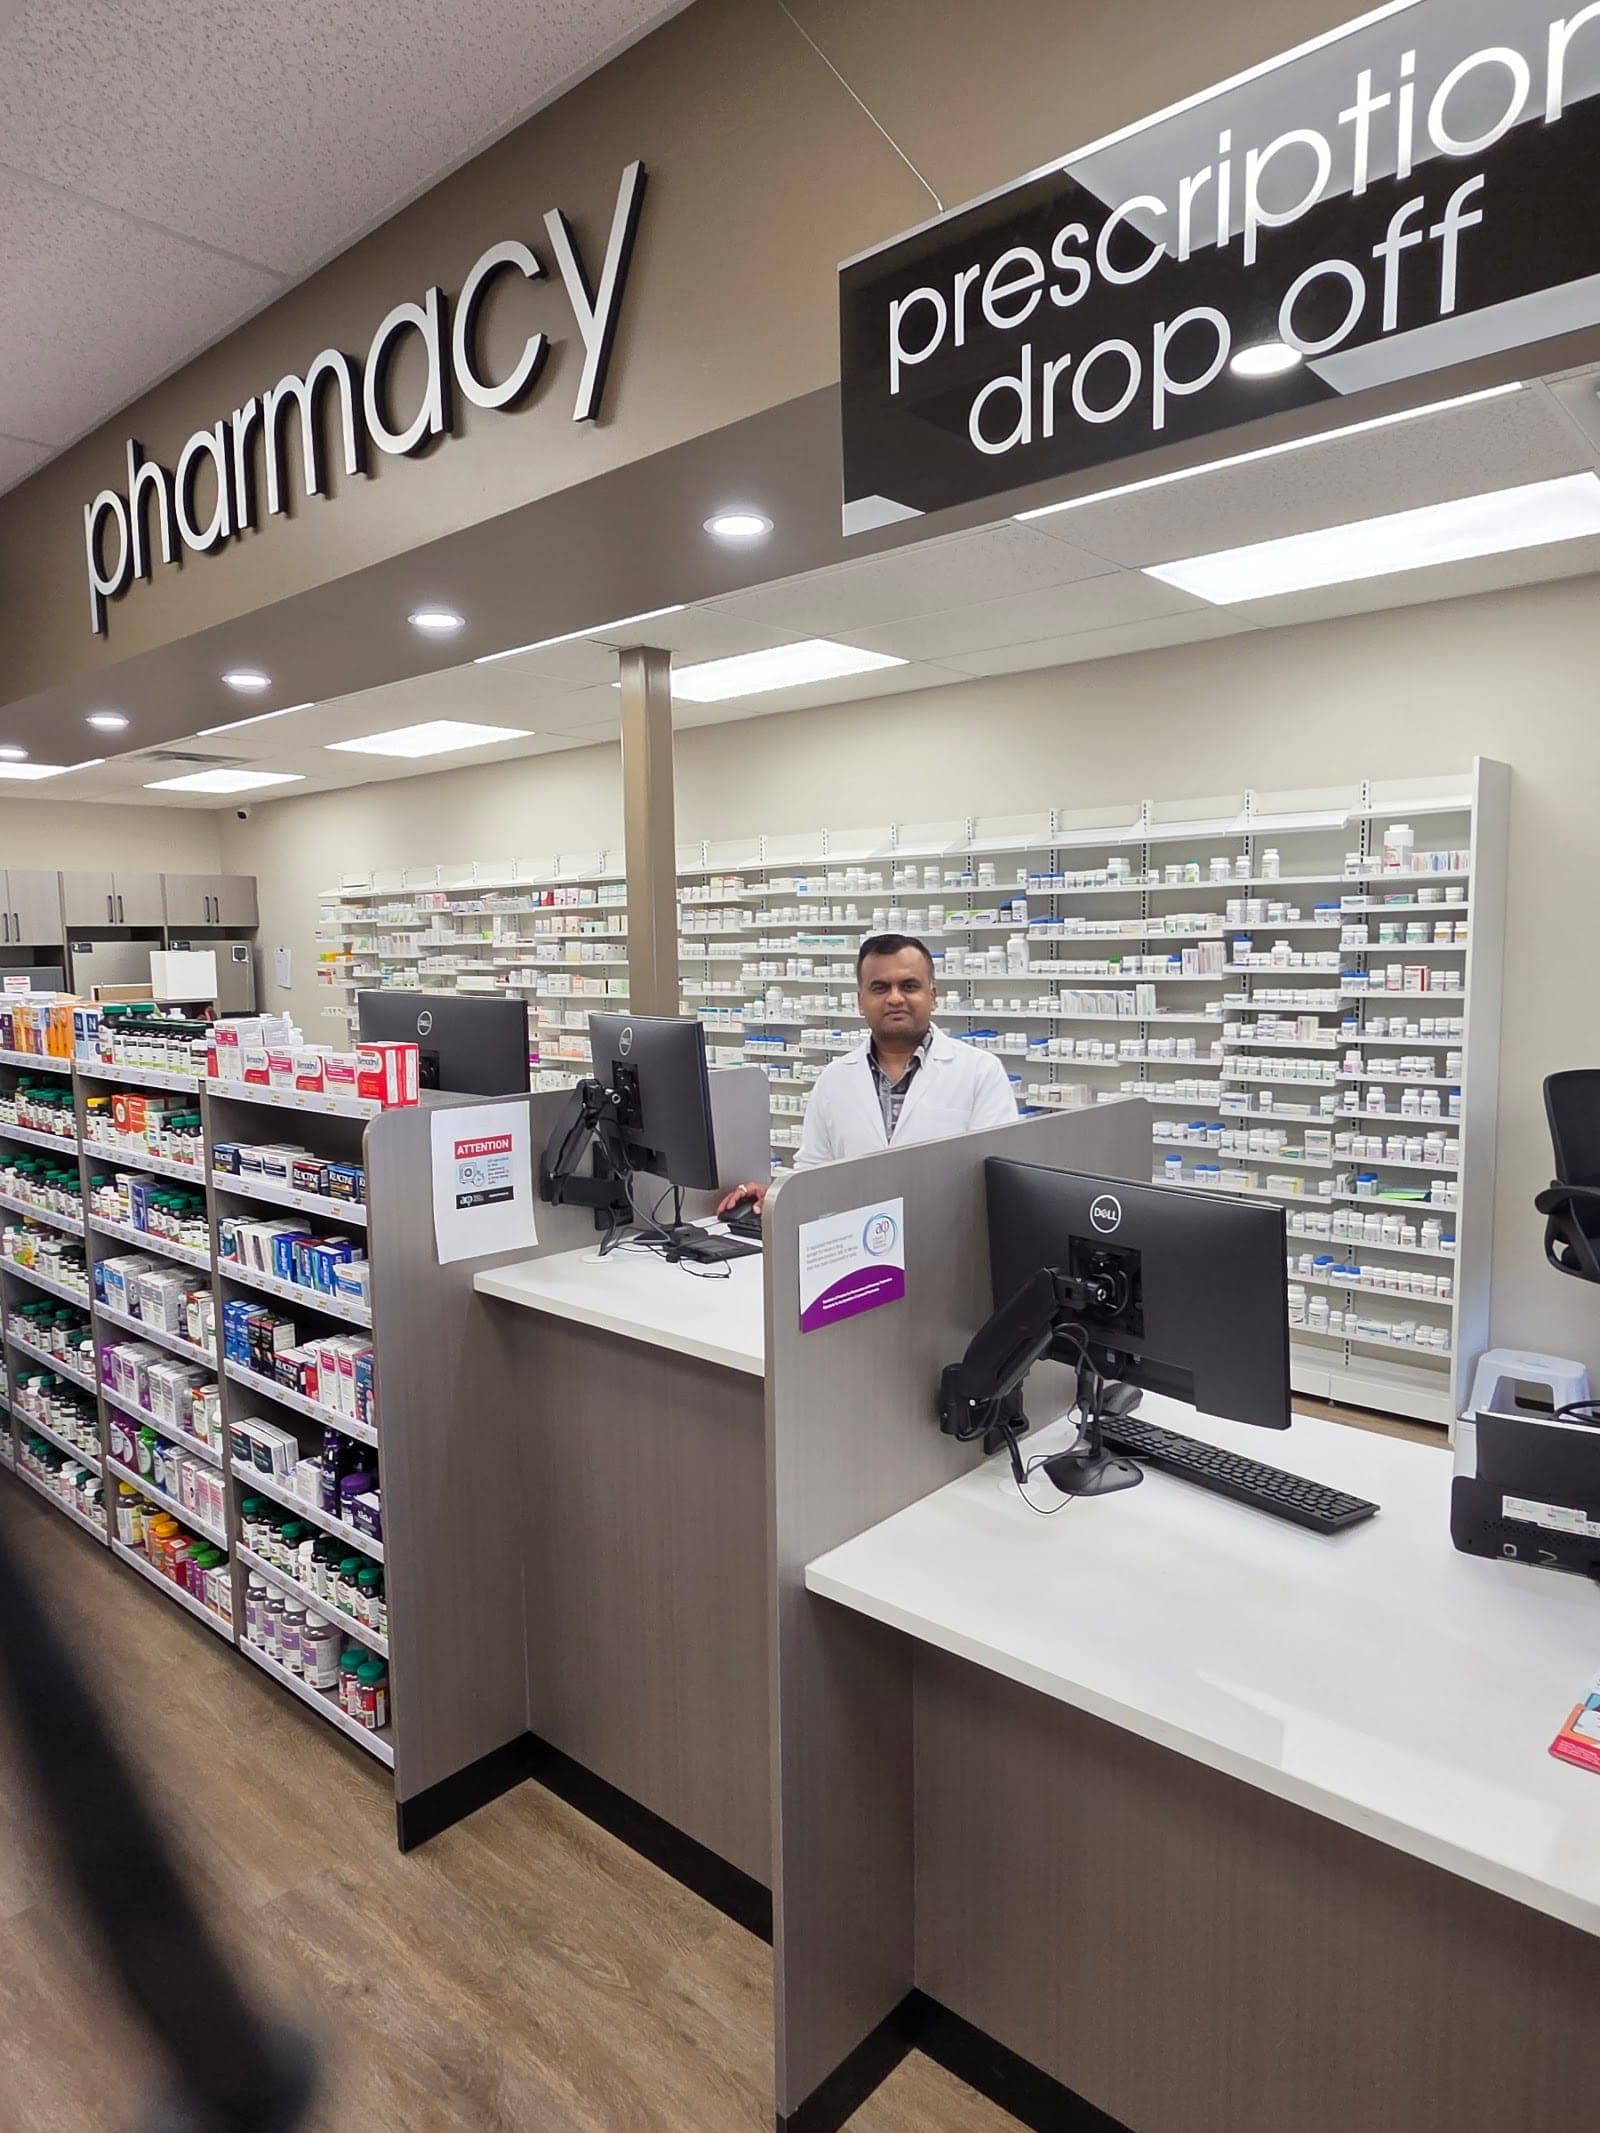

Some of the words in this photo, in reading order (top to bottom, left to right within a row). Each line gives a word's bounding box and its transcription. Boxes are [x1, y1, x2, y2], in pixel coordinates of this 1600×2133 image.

[969, 306, 1231, 455] drop
[1278, 174, 1484, 355] off
[84, 160, 643, 634] pharmacy
[456, 1138, 509, 1156] ATTENTION
[1094, 1207, 1118, 1221] DELL
